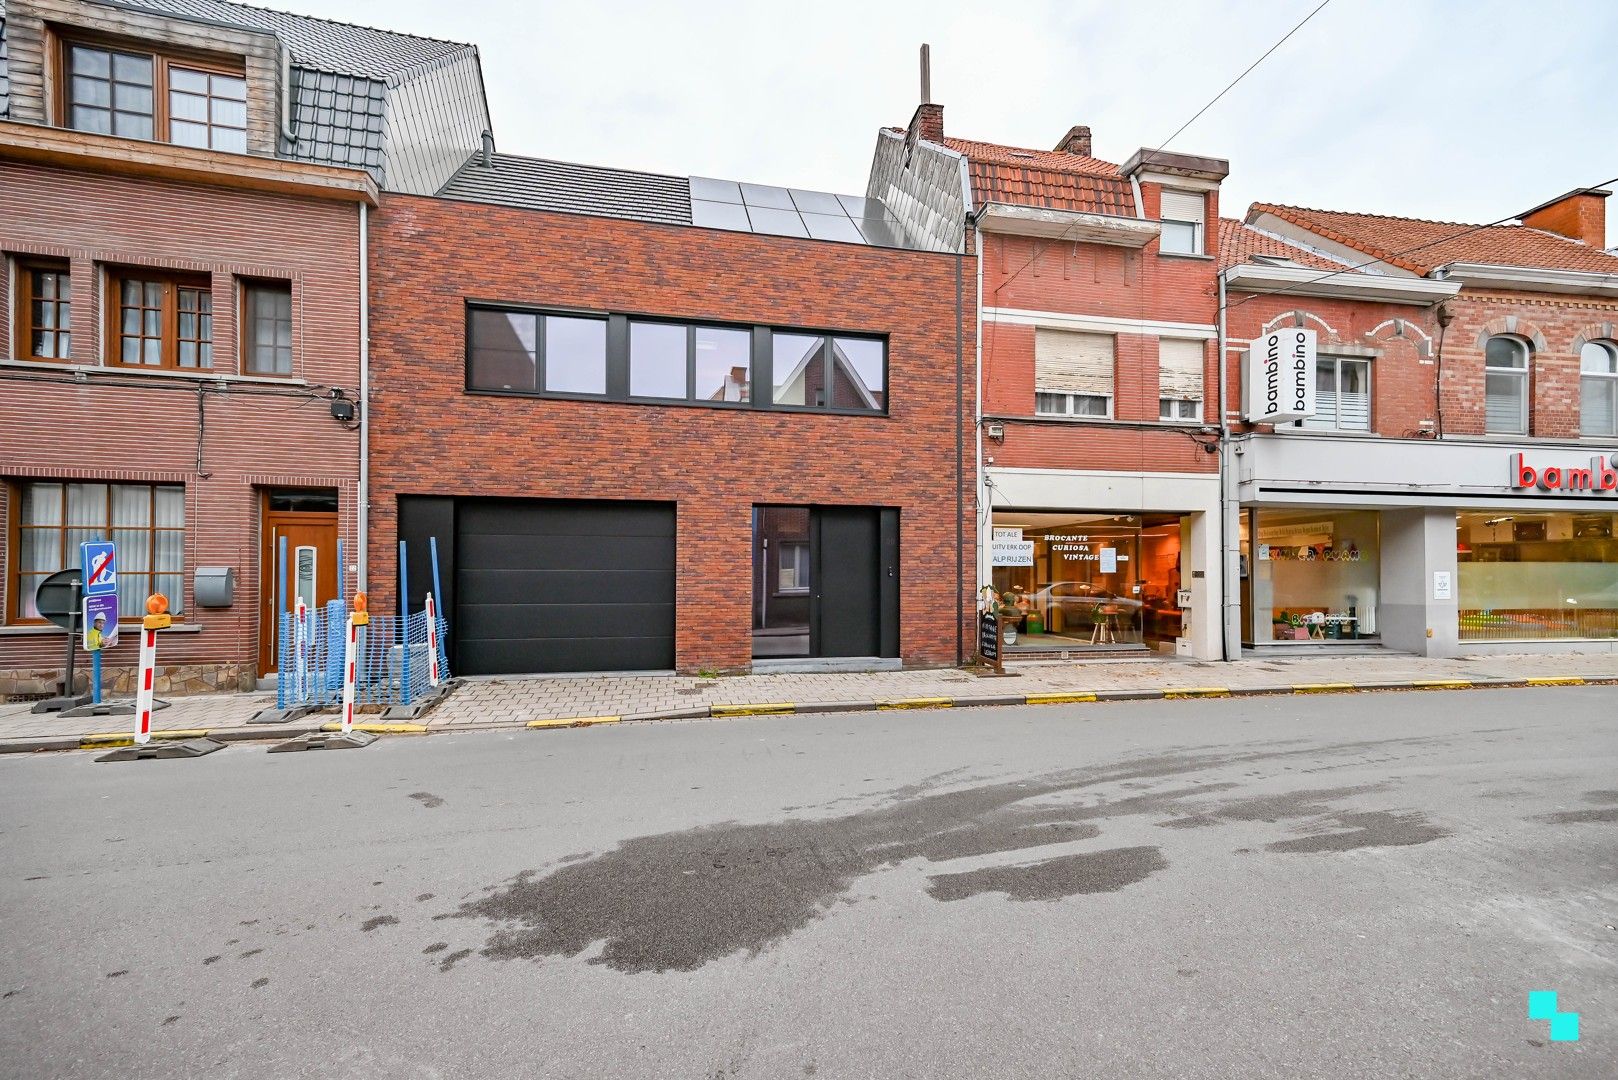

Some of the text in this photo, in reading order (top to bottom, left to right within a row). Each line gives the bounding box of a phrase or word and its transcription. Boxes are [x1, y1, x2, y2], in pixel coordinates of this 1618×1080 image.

[1264, 335, 1279, 415] bambino
[1292, 332, 1306, 411] bambino
[1509, 452, 1618, 490] bamb
[1043, 534, 1089, 542] BROCANTE
[1052, 544, 1089, 552] CURIOSA
[1063, 553, 1100, 561] VINTAGE
